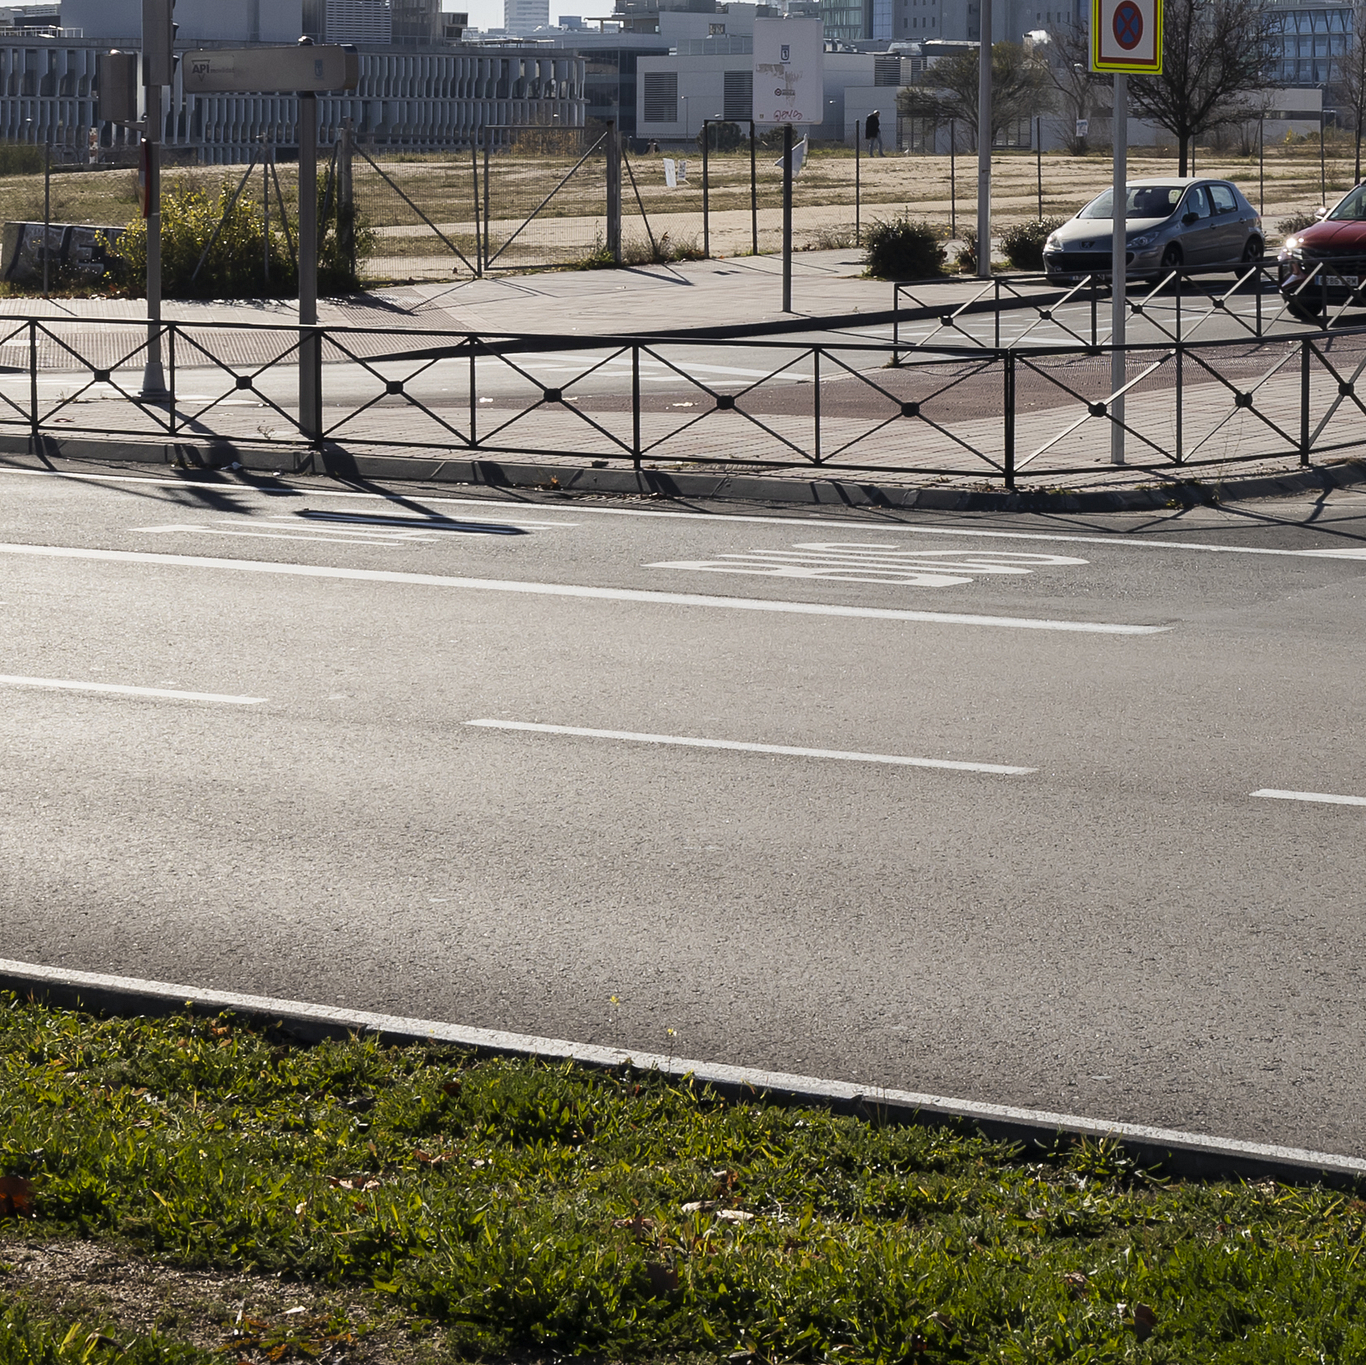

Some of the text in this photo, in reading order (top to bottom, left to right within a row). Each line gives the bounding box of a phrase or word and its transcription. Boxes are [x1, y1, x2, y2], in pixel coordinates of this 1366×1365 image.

[192, 64, 210, 74] API
[128, 508, 580, 546] TAXI
[640, 542, 1090, 587] BUS
